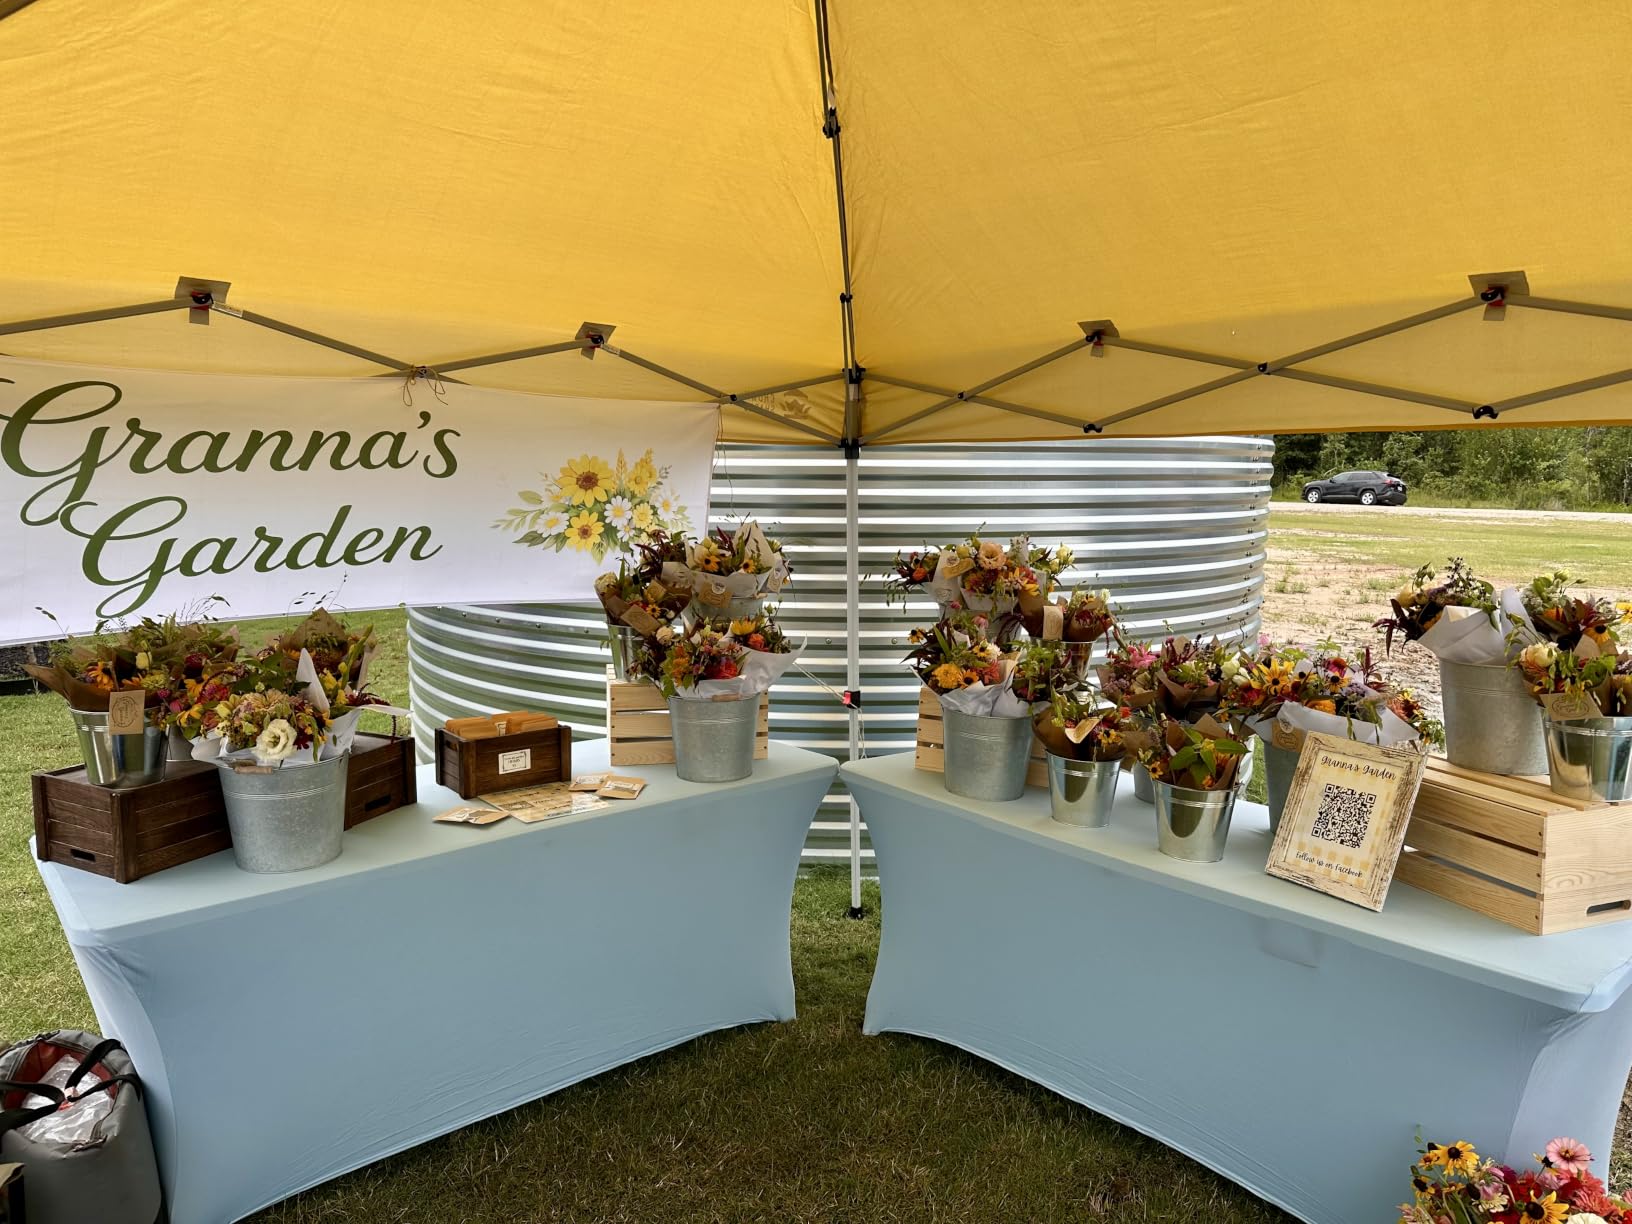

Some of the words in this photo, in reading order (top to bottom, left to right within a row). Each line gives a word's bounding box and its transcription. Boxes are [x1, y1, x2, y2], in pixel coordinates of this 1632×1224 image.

[0, 378, 461, 526] Granna's
[60, 496, 442, 619] Garden
[1321, 755, 1360, 771] Granna's
[1363, 765, 1396, 780] Garden
[1296, 851, 1315, 864] Follow
[1325, 862, 1334, 870] on
[1335, 863, 1363, 878] Facebook
